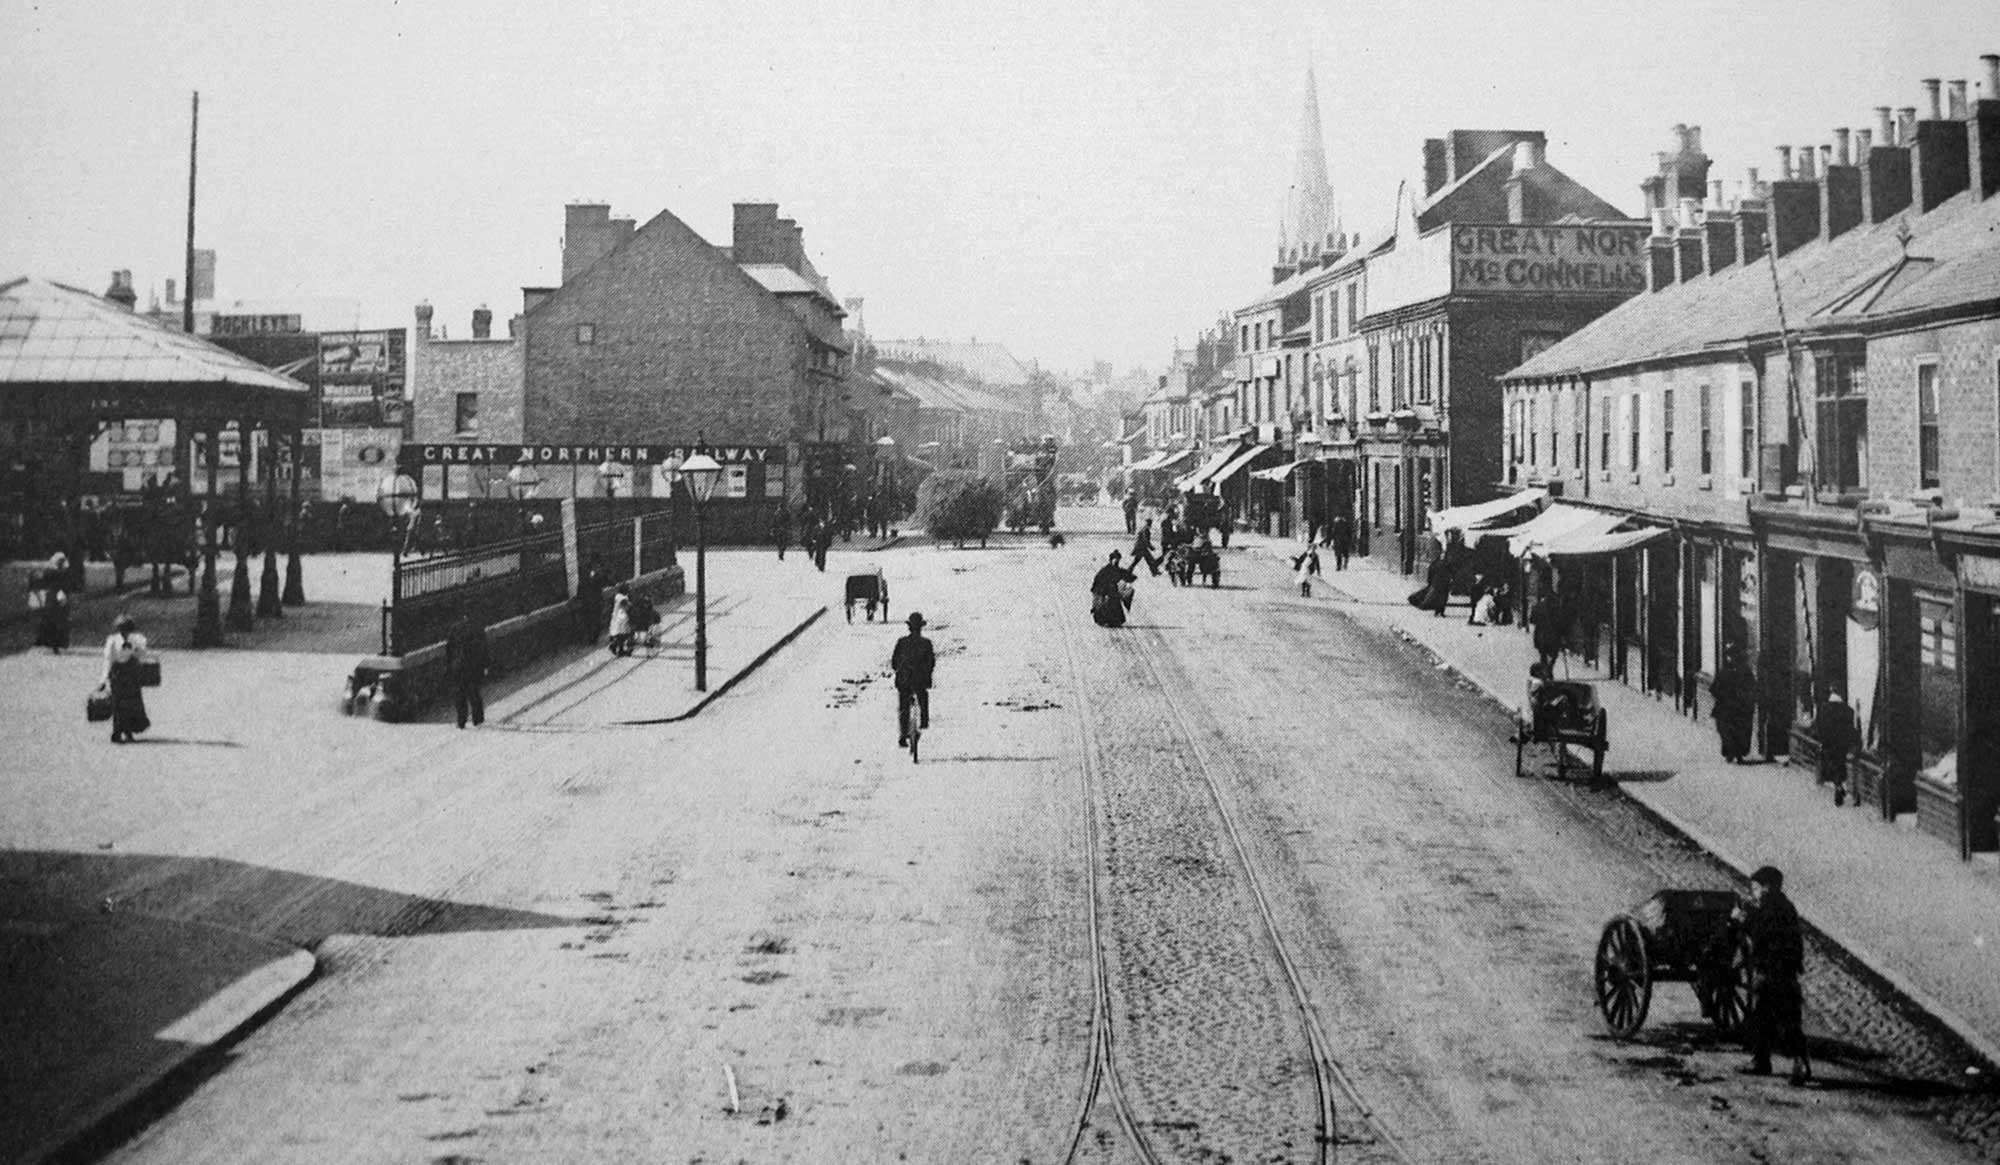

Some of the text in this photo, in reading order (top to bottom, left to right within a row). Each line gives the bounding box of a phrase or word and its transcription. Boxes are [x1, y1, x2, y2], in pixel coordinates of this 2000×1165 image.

[1456, 227, 1650, 256] GREAT NOR
[424, 446, 497, 460] GREAT
[522, 447, 648, 461] NORTHERN
